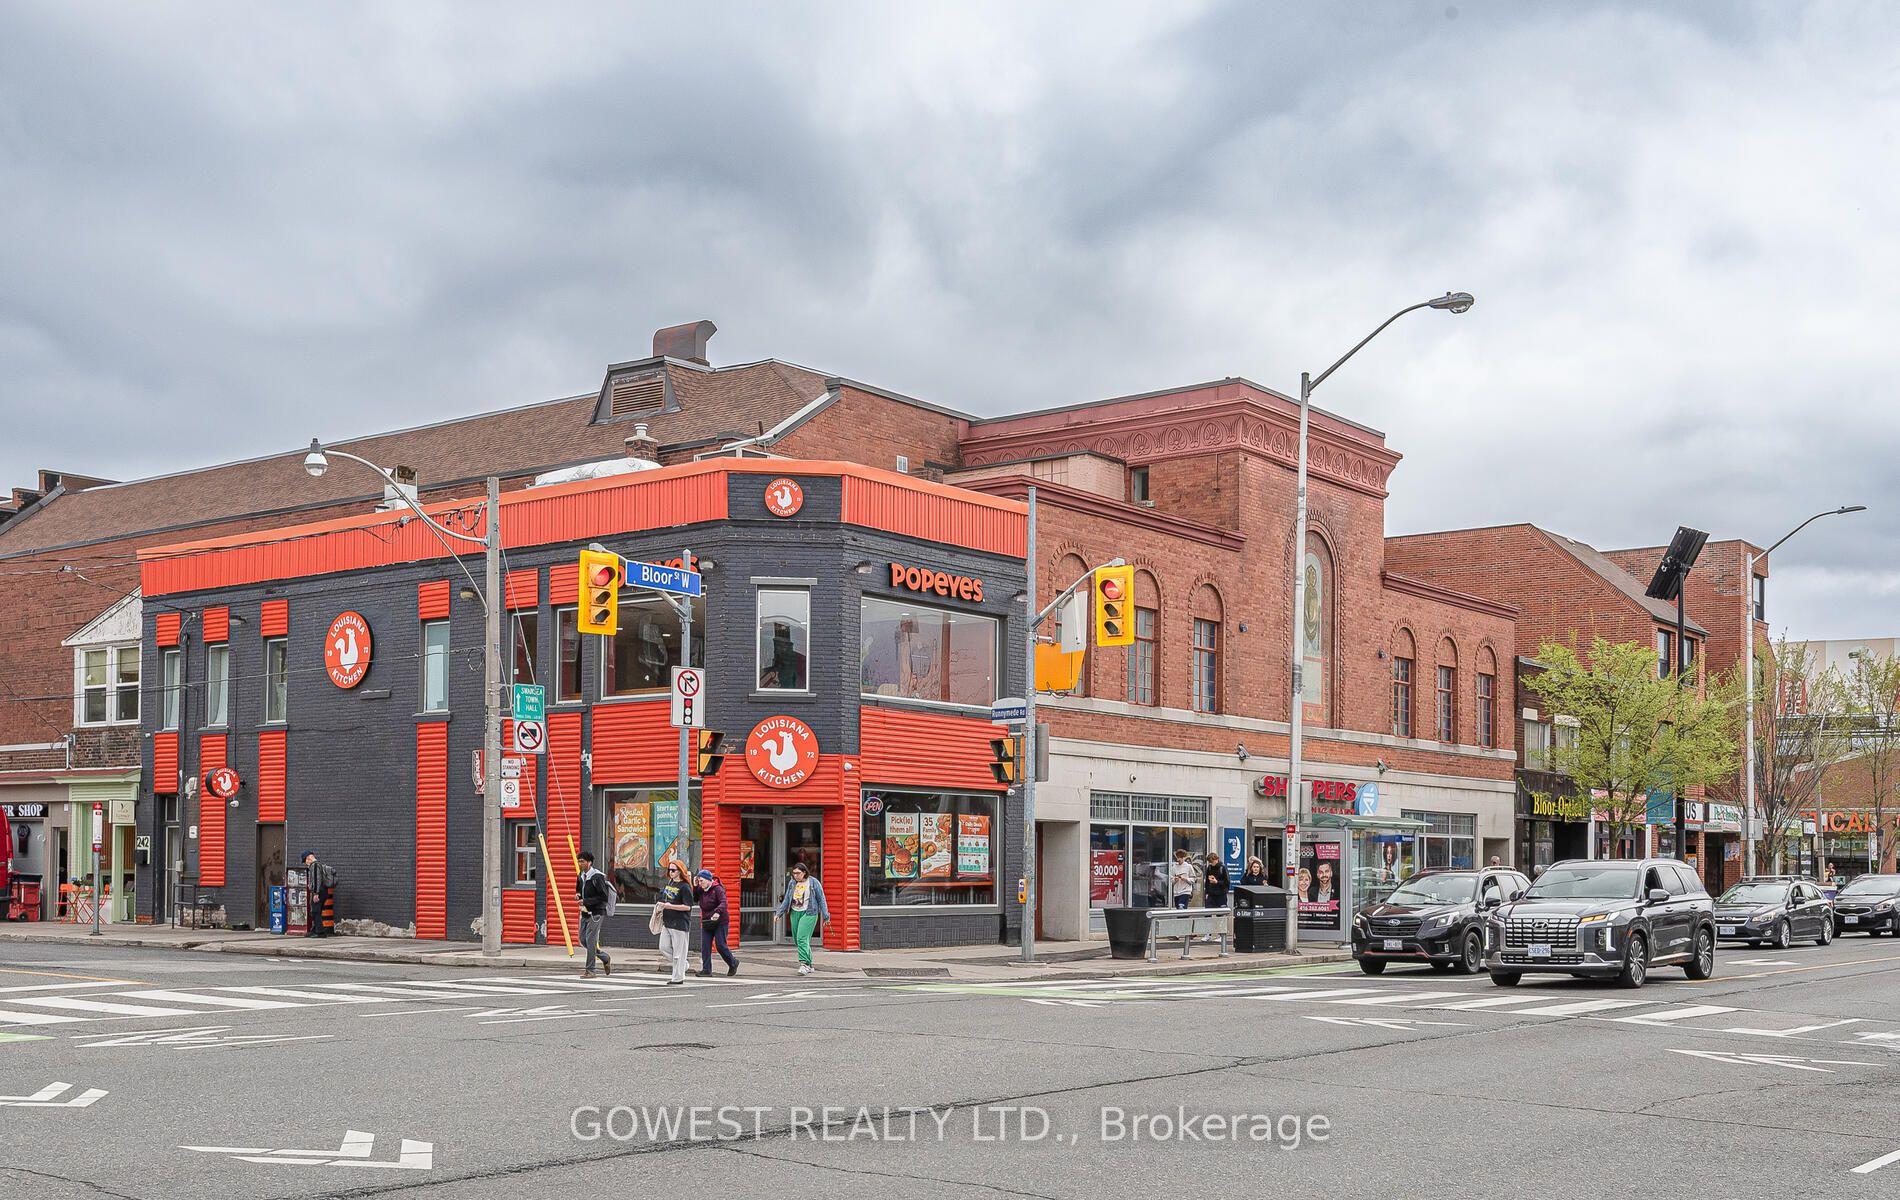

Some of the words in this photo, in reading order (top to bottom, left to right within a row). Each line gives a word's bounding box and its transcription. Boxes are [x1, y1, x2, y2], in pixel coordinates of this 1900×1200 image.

[770, 479, 799, 492] LOUISIANA
[770, 505, 796, 515] KITCHEN
[642, 566, 673, 585] Bloor
[673, 571, 680, 580] St
[681, 573, 690, 588] W
[330, 616, 365, 638] LOUISIANA
[331, 666, 363, 685] KITCHEN
[525, 695, 539, 703] TOWN
[992, 708, 1020, 719] Runnymede
[755, 719, 810, 741] LOUISIANA
[806, 751, 815, 759] 72
[757, 767, 805, 785] KITCHEN
[1263, 776, 1357, 802] SHPERS
[18, 803, 43, 817] SHOP
[864, 801, 880, 811] OPEN
[1532, 793, 1556, 816] Bloor
[623, 817, 641, 825] Garlic
[617, 824, 647, 833] Sandwich
[136, 836, 149, 848] 242
[1093, 865, 1119, 876] 30,000
